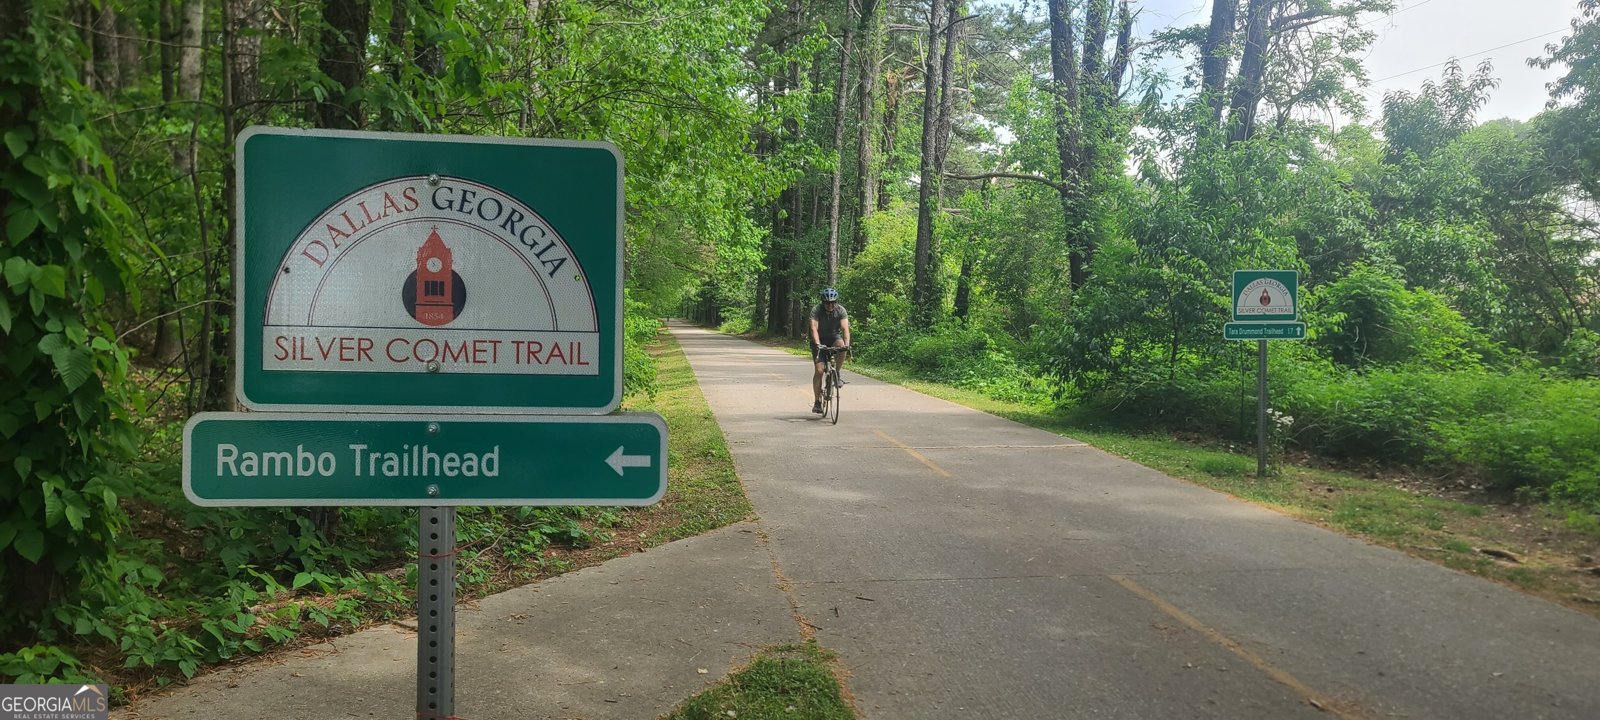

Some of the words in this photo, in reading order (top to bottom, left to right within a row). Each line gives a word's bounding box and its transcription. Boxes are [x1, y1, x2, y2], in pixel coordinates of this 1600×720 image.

[302, 187, 420, 268] DALLAS
[431, 185, 568, 278] GEORGIA
[1264, 327, 1284, 335] Trailhead
[273, 335, 374, 362] SILVER
[385, 338, 502, 364] COMET
[511, 340, 590, 366] TRAIL
[216, 443, 336, 477] Rambo
[349, 444, 500, 477] Trailhead
